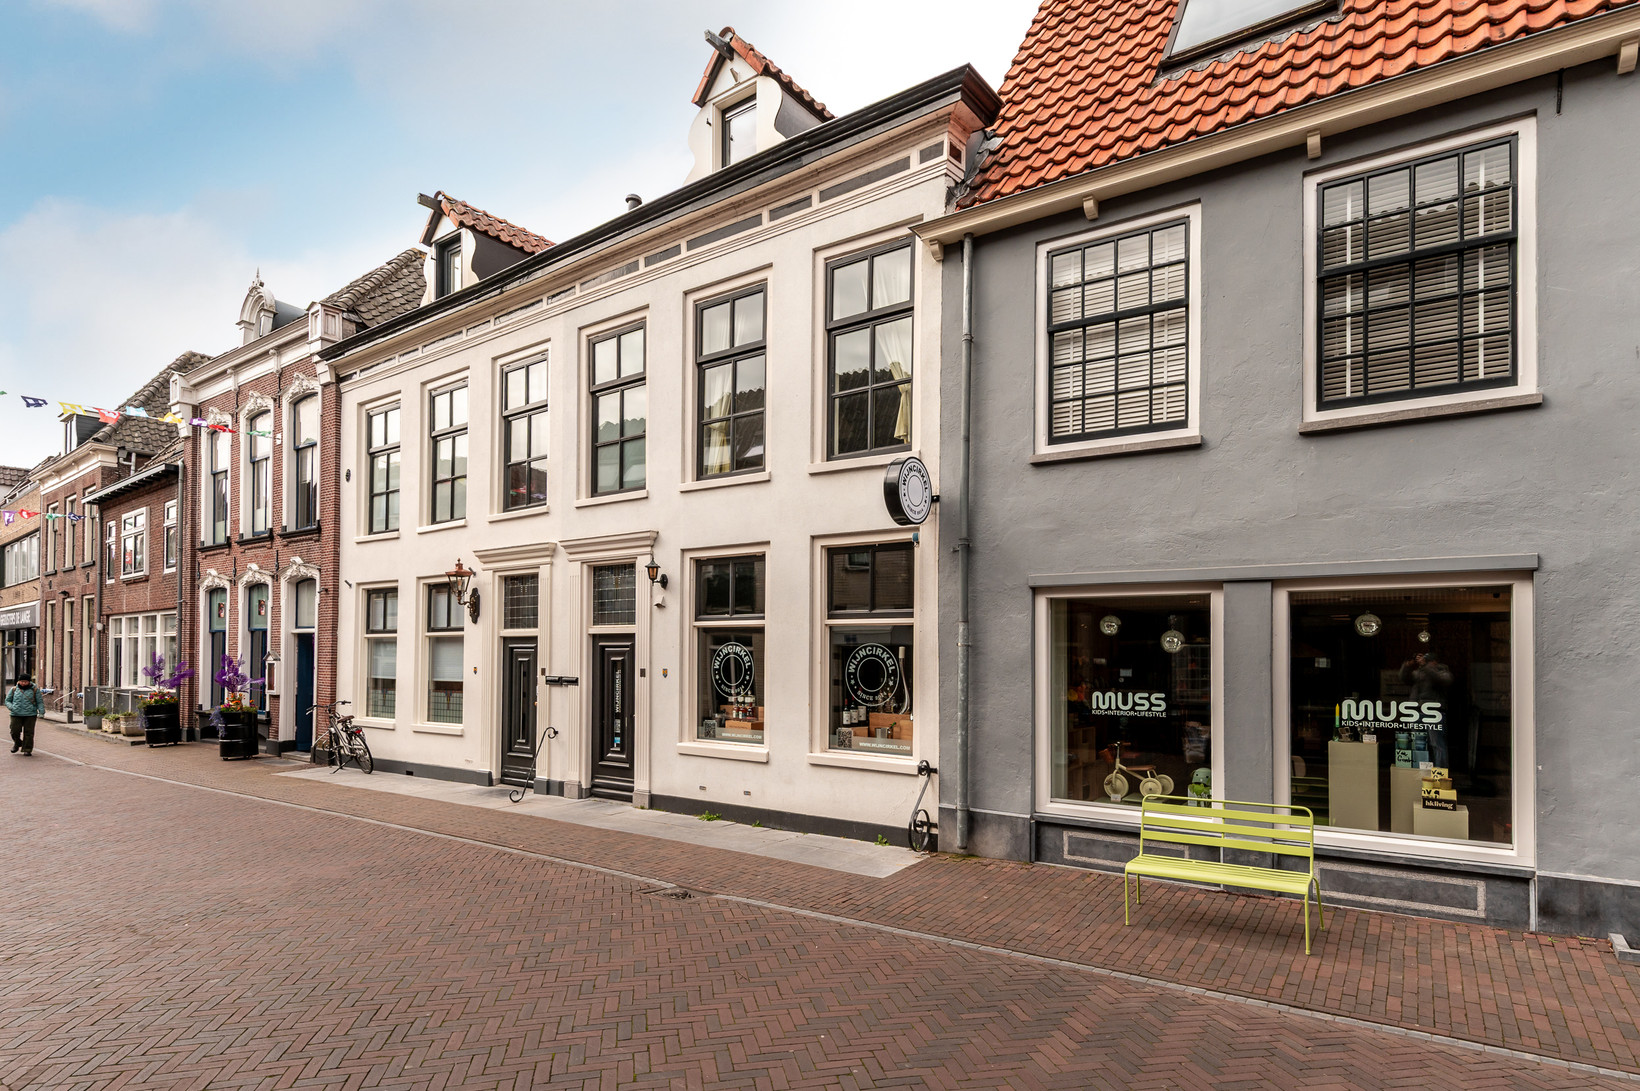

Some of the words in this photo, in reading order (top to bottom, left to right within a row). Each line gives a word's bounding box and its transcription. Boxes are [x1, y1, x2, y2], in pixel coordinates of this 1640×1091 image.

[902, 464, 928, 492] WIJNCIRKEL
[713, 645, 751, 669] WIJNCIRKEL
[848, 646, 896, 674] WIJNCIRKEL
[857, 690, 874, 701] SINCE
[1091, 691, 1167, 712] MUSS
[1341, 699, 1443, 723] MUSS
[1425, 800, 1454, 810] hkliving
